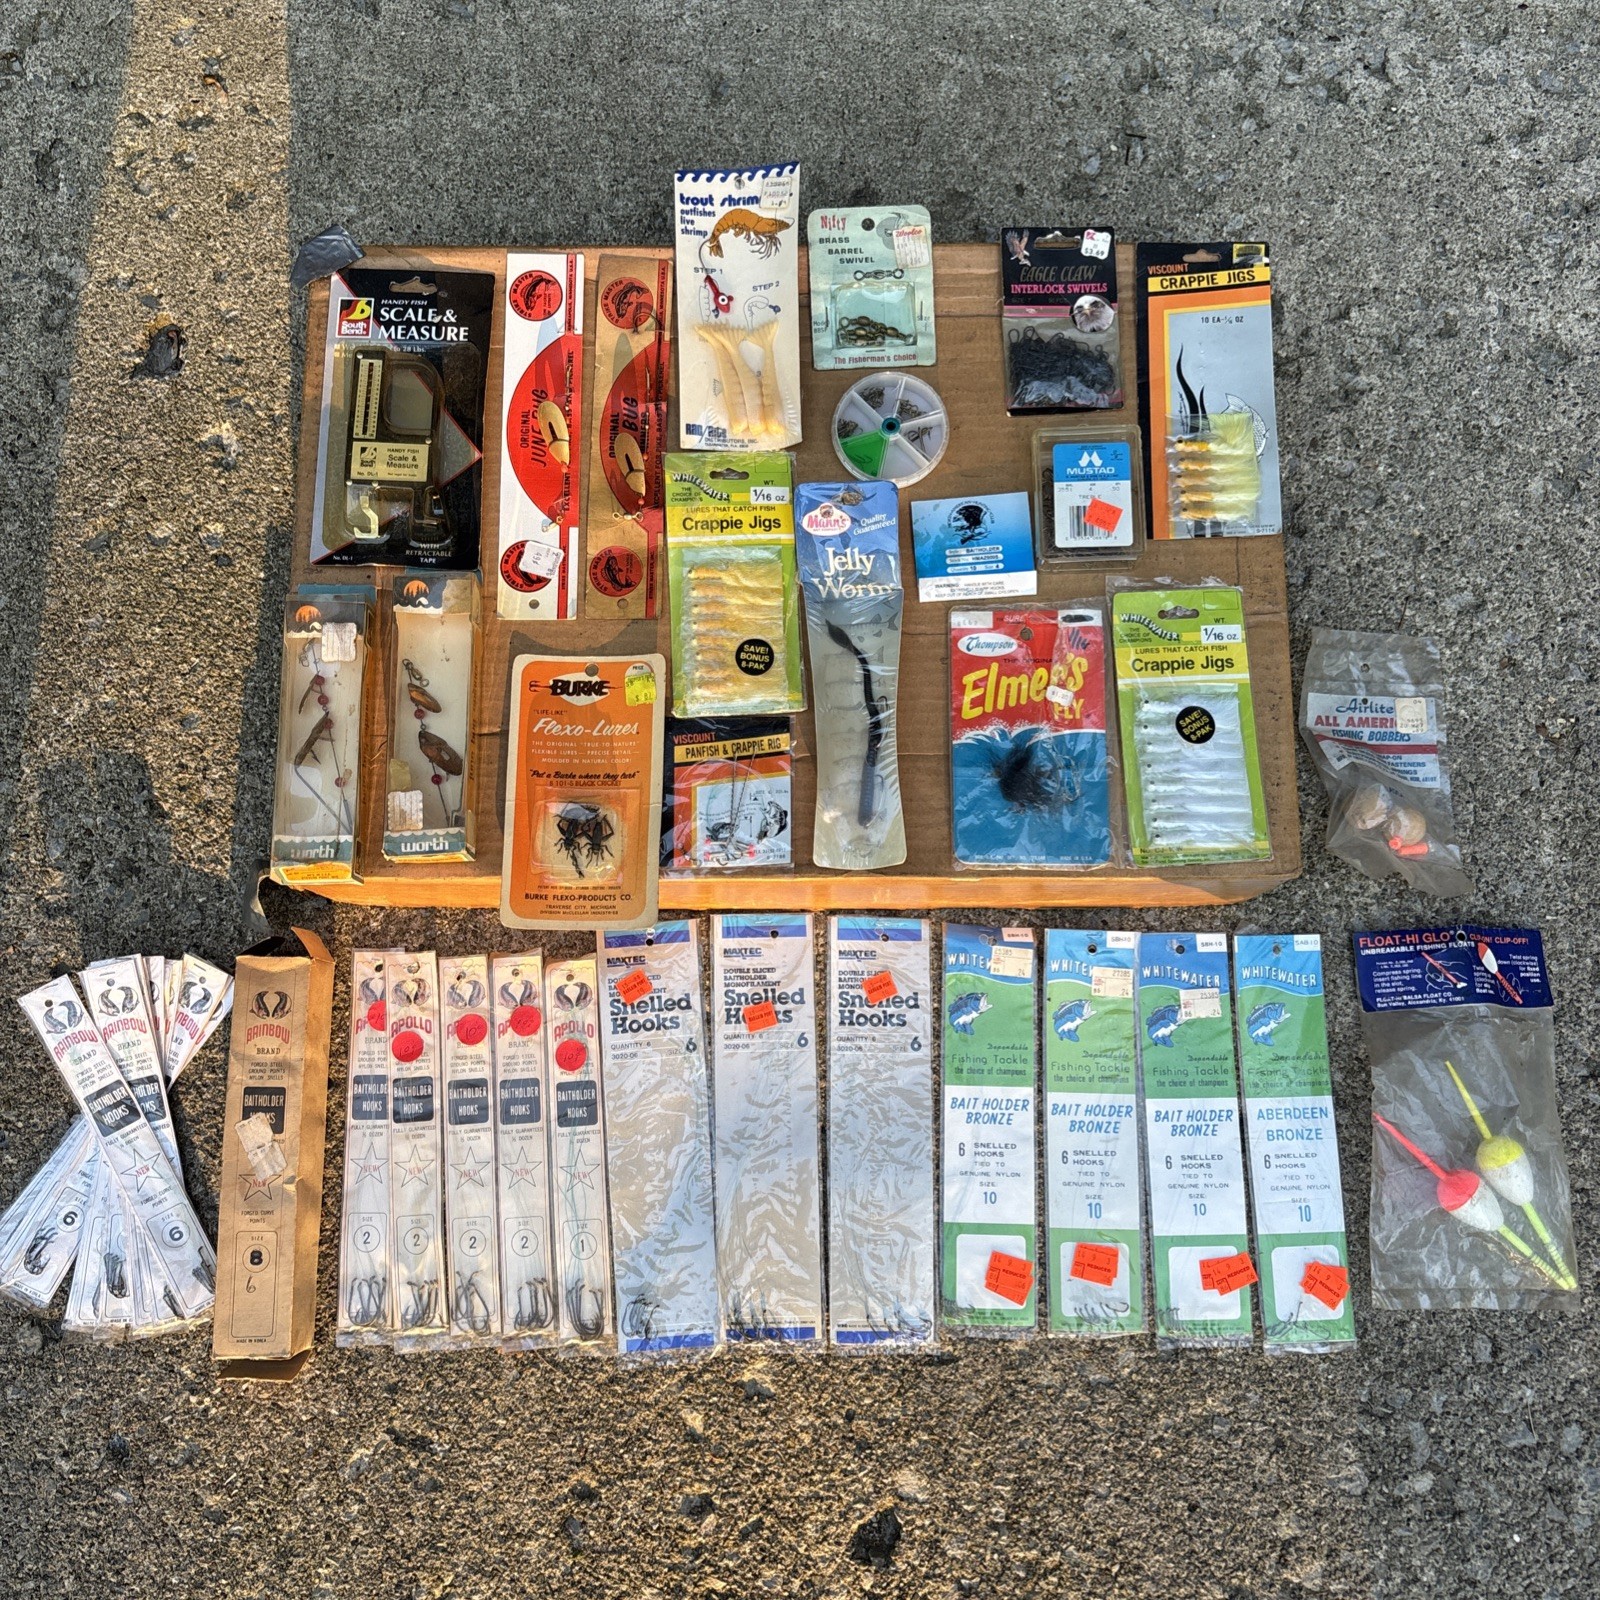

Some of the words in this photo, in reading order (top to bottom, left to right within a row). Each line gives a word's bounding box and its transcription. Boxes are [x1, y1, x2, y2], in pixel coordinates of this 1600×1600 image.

[679, 192, 715, 207] trout
[680, 206, 716, 218] outfishes
[680, 215, 695, 226] live
[820, 214, 846, 231] Nifty
[680, 226, 708, 239] shrimp
[895, 228, 923, 238] Woolco
[818, 236, 850, 245] BRASS
[827, 247, 864, 255] BARREL
[1084, 247, 1105, 257] $3.69
[839, 257, 875, 265] SWIVEL
[1147, 262, 1189, 275] VISCOUNT
[1020, 266, 1059, 282] EAGLE
[1060, 265, 1097, 281] CLAW
[1160, 273, 1219, 290] CRAPPIE
[1226, 269, 1256, 284] JIGS
[1010, 284, 1066, 294] INTERLOCK
[1066, 282, 1108, 293] SWIVELS
[379, 307, 438, 322] SCALE
[442, 308, 458, 323] &
[341, 320, 367, 329] South
[378, 325, 469, 342] MEASURE
[834, 356, 847, 365] The
[848, 355, 891, 364] Fisherman's
[893, 353, 917, 362] Choice
[622, 396, 639, 433] BUG
[520, 409, 531, 449] ORIGINAL
[386, 460, 419, 470] Measure
[1066, 466, 1115, 475] MUSTAD
[672, 472, 731, 503] WHITEWATER
[682, 515, 744, 534] Crappie
[748, 515, 782, 532] Jigs
[806, 513, 847, 529] Mann's
[853, 518, 896, 536] Guaranteed
[860, 513, 887, 527] Quality
[405, 549, 452, 557] RETRACTABLE
[823, 546, 876, 577] Jelly
[810, 576, 891, 599] Worm
[1203, 627, 1224, 642] 1/16
[743, 644, 769, 654] SAVE!
[966, 636, 1014, 653] Thompson
[740, 652, 770, 663] BONUS
[1131, 656, 1195, 675] Crappie
[1200, 655, 1235, 673] Jigs
[740, 661, 766, 671] 8-PAK
[550, 679, 609, 697] BURKE
[960, 652, 1089, 720] Elmer's
[1335, 698, 1394, 715] Airlite
[1179, 709, 1202, 726] SAVE!
[532, 717, 638, 737] Flexo-Lures
[1182, 716, 1210, 735] BONUS
[672, 732, 716, 745] VISCOUNT
[1331, 729, 1364, 741] FISHING
[1367, 730, 1411, 742] BOBBERS
[685, 744, 720, 759] PANFISH
[722, 744, 729, 756] &
[730, 740, 766, 754] CRAPPIE
[767, 737, 782, 750] RIG
[401, 836, 450, 853] worth
[524, 893, 549, 901] BURKE
[1359, 933, 1420, 948] FLOAT-HI
[1422, 932, 1450, 943] GLO
[1469, 933, 1493, 944] CLIP-ON!
[1495, 937, 1529, 945] CLIP-OFF!
[723, 947, 762, 957] MAXTEC
[838, 950, 877, 959] MAXTEC
[1360, 945, 1415, 956] UNBREAKABLE
[1416, 943, 1447, 951] FISHING
[1448, 941, 1475, 949] FLOATS
[1142, 965, 1220, 988] WHITEWATER
[1241, 965, 1317, 987] WHITEWATER
[723, 980, 781, 988] MONOFILAMENT
[609, 992, 692, 1017] Snelled
[724, 987, 806, 1007] Snelled
[610, 1014, 681, 1035] Hooks
[838, 1009, 907, 1028] Hooks
[102, 1017, 147, 1044] RAINBOW
[246, 1023, 291, 1045] RAINBOW
[390, 1015, 432, 1038] APOLLO
[553, 1020, 595, 1042] APOLLO
[256, 1047, 281, 1055] BRAND
[910, 1035, 922, 1052] 6
[951, 1054, 988, 1066] Fishing
[994, 1054, 1028, 1065] Tackle
[1051, 1062, 1091, 1073] Fishing
[1094, 1062, 1130, 1073] Tackle
[1152, 1067, 1189, 1077] Fishing
[1194, 1066, 1229, 1076] Tackle
[244, 1094, 284, 1107] BAITHOLDER
[557, 1089, 596, 1102] BAITHOLDER
[950, 1097, 979, 1110] BAIT
[981, 1098, 1030, 1112] HOLDER
[1051, 1103, 1082, 1116] BAIT
[1084, 1104, 1133, 1118] HOLDER
[965, 1112, 1014, 1126] BRONZE
[1154, 1110, 1182, 1122] BAIT
[1186, 1109, 1233, 1122] HOLDER
[1257, 1106, 1329, 1121] ABERDEEN
[1068, 1120, 1121, 1134] BRONZE
[1170, 1124, 1218, 1137] BRONZE
[1266, 1128, 1323, 1142] BRONZE
[958, 1142, 966, 1157] 6
[974, 1142, 1017, 1150] SNELLED
[1062, 1150, 1069, 1165] 6
[1073, 1158, 1105, 1166] HOOKS
[135, 1164, 151, 1178] NEW
[983, 1191, 997, 1205] 10
[1087, 1202, 1102, 1219] 10
[62, 1211, 78, 1226] 6
[168, 1226, 184, 1242] 6
[362, 1231, 371, 1245] 2
[412, 1233, 421, 1247] 2
[1227, 1265, 1250, 1280] REDUCED
